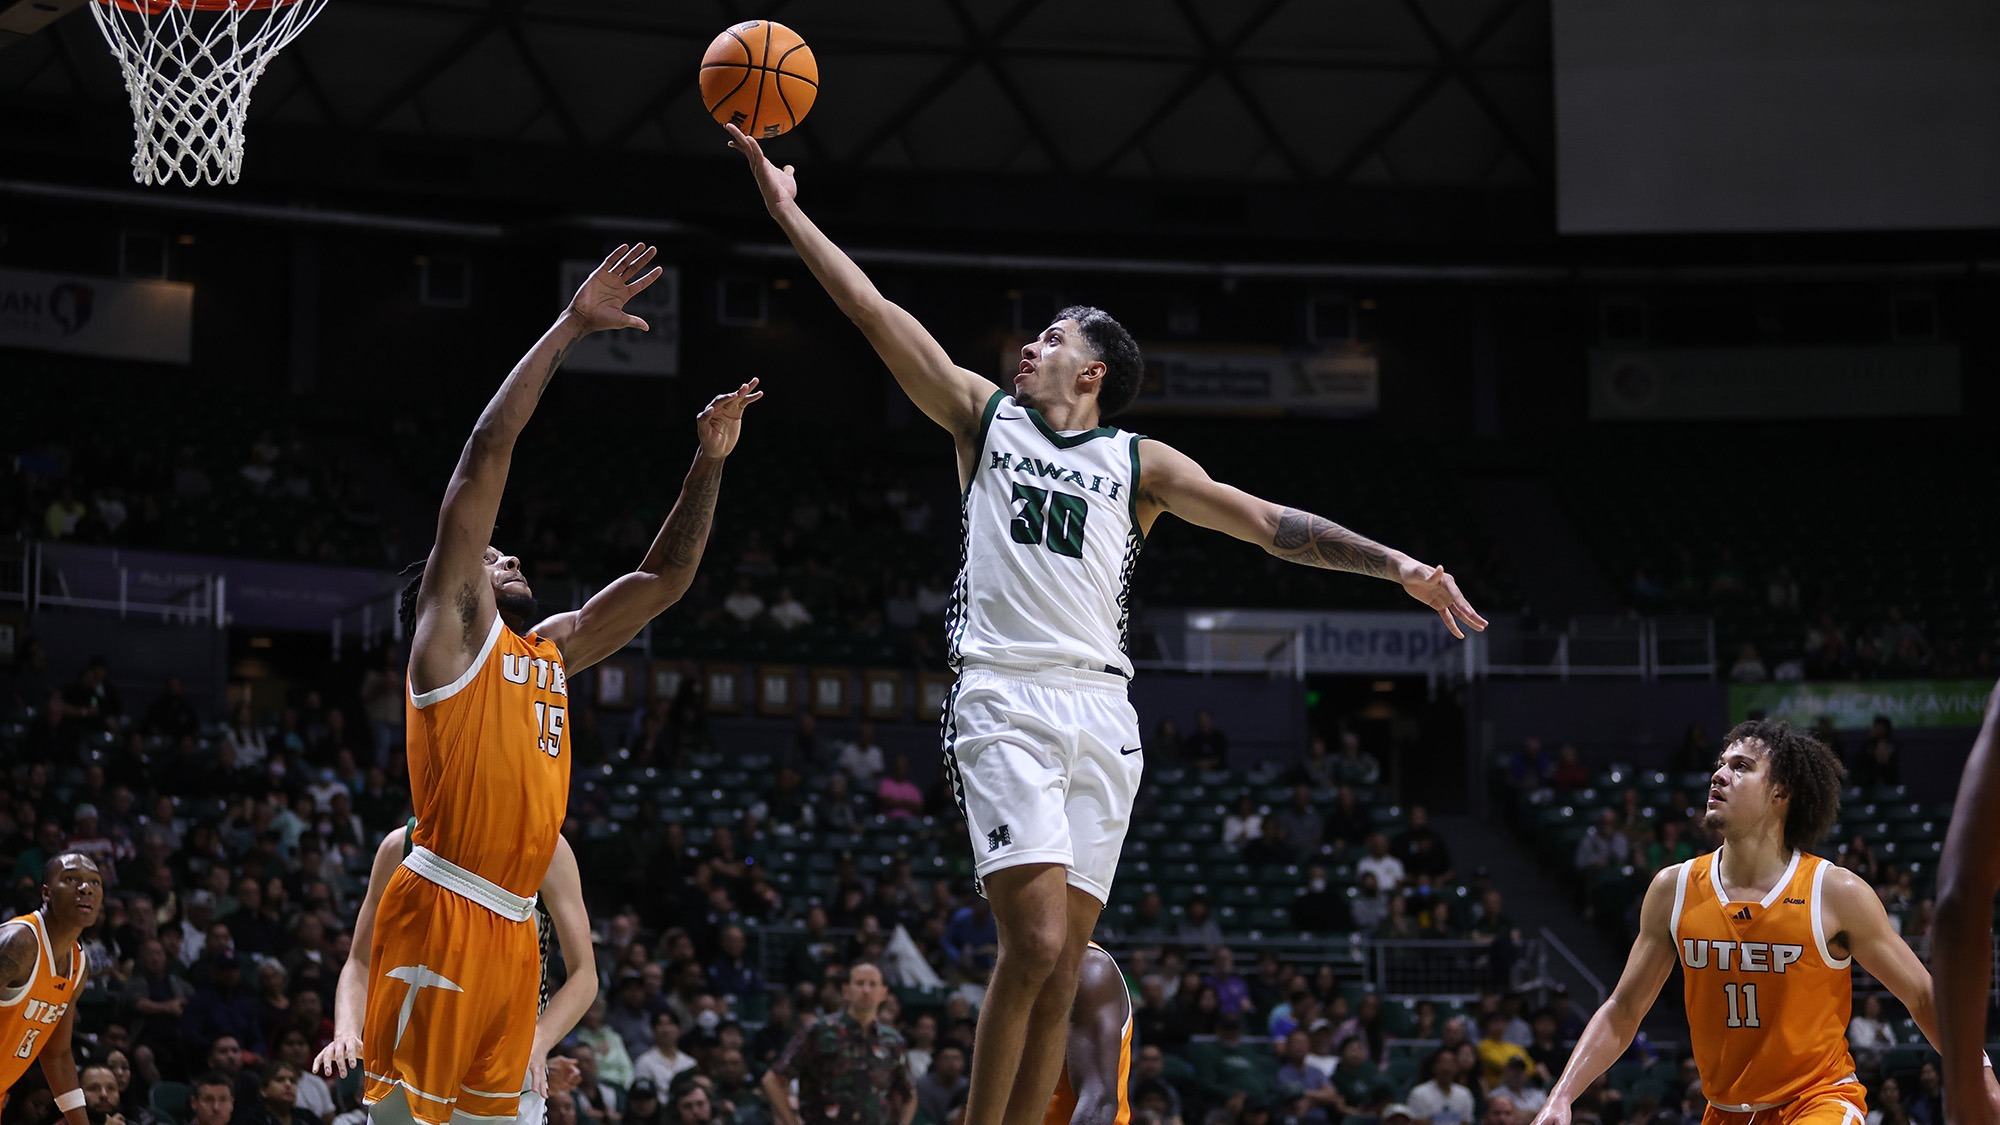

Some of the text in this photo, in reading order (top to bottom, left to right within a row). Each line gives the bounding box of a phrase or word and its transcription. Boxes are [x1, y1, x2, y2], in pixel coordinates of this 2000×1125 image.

[1010, 481, 1088, 559] 30
[502, 652, 568, 698] UTE
[534, 700, 565, 758] 15
[1683, 938, 1803, 974] UTEP
[1724, 982, 1760, 1028] 11
[13, 1028, 41, 1059] 13
